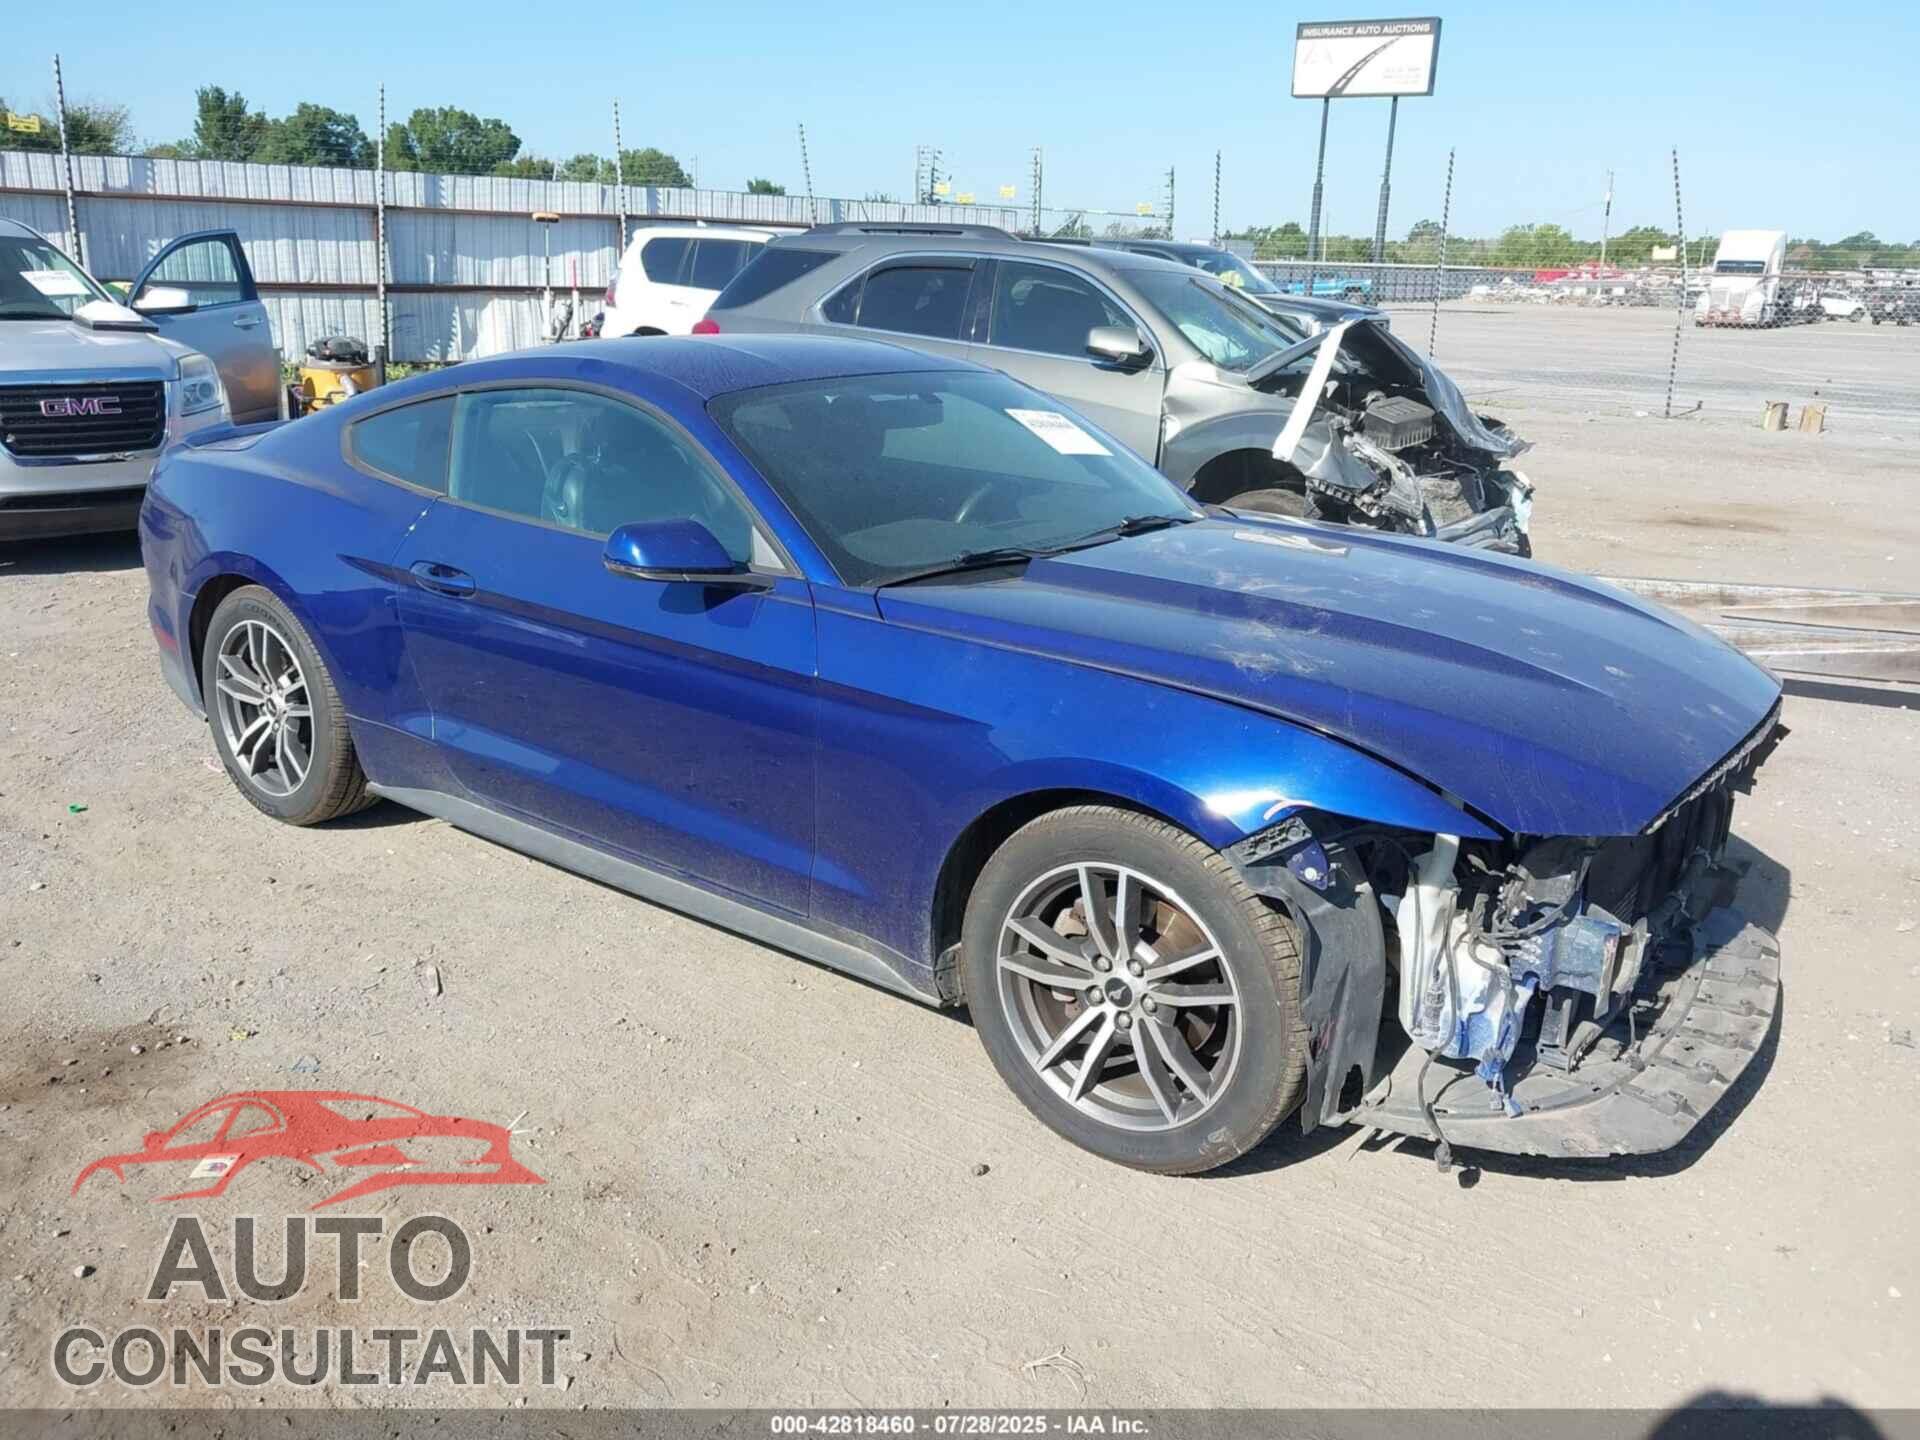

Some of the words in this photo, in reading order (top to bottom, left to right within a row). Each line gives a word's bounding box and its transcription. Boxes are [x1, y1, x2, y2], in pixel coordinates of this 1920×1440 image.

[1302, 26, 1354, 37] INSURANCE
[1355, 25, 1380, 35] AUTO
[1382, 23, 1430, 34] AUCTIONS
[40, 397, 122, 416] GMC
